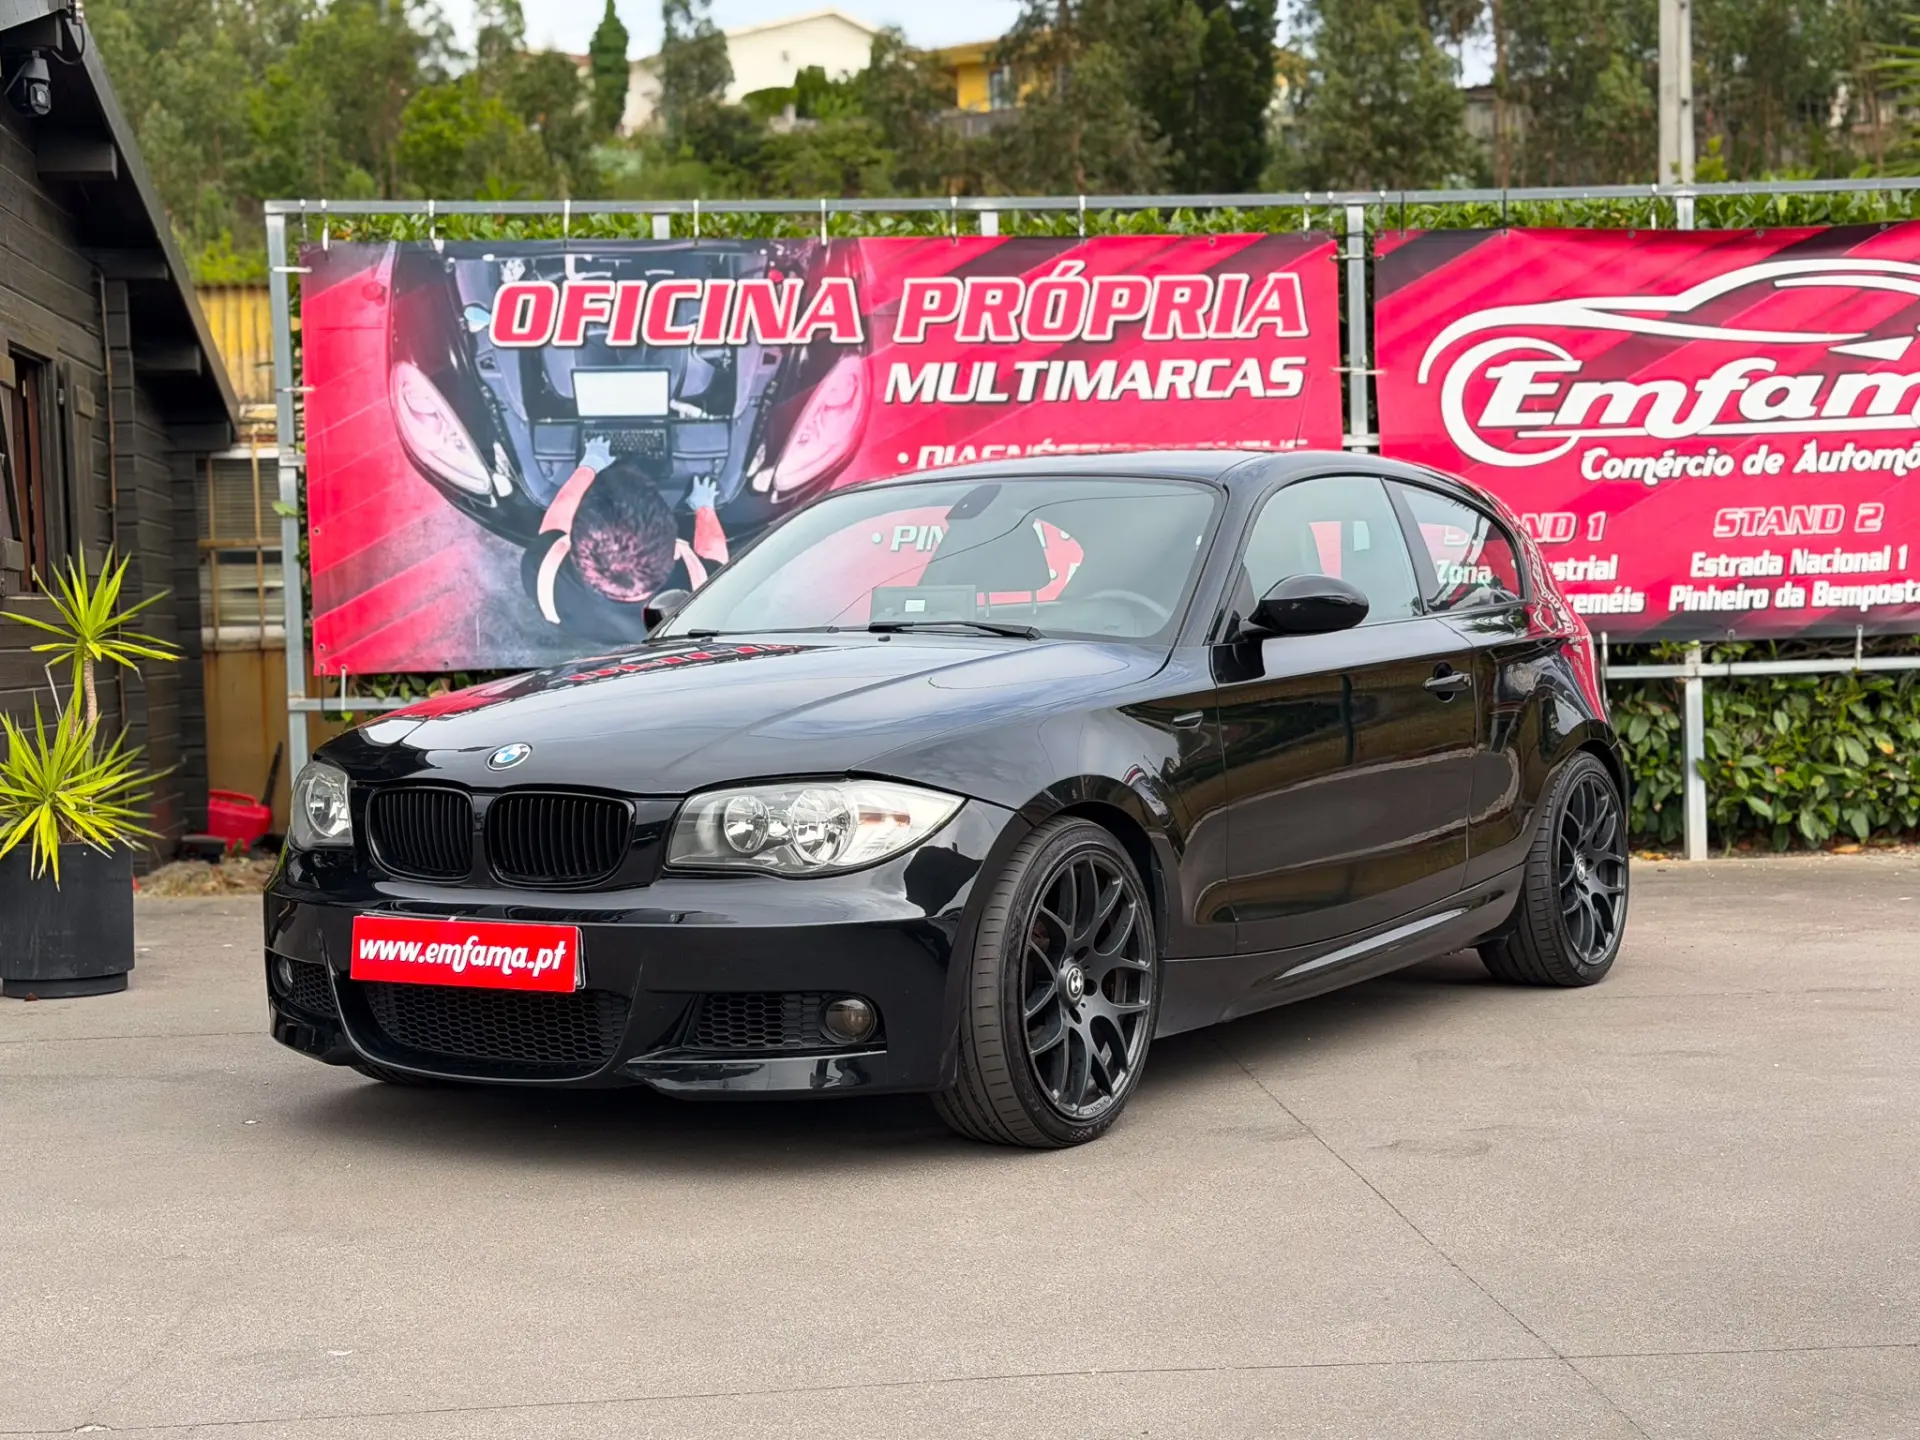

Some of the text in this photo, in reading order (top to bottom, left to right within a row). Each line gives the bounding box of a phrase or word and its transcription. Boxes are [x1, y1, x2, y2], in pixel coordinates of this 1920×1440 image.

[489, 260, 1309, 346] OFICINA PRÓPRIA
[884, 357, 1307, 402] MULTIMARCAS
[1477, 357, 1920, 439] Emfam
[1581, 439, 1920, 485] Comércio de Automó
[1587, 511, 1606, 541] 1
[1713, 503, 1884, 537] STAND 2
[1436, 554, 1618, 584] Zona strial
[1690, 544, 1908, 577] Estrada Nacional 1
[1668, 583, 1769, 611] Pinheiro
[1775, 581, 1806, 608] da
[360, 935, 567, 977] www.emfama.pt
